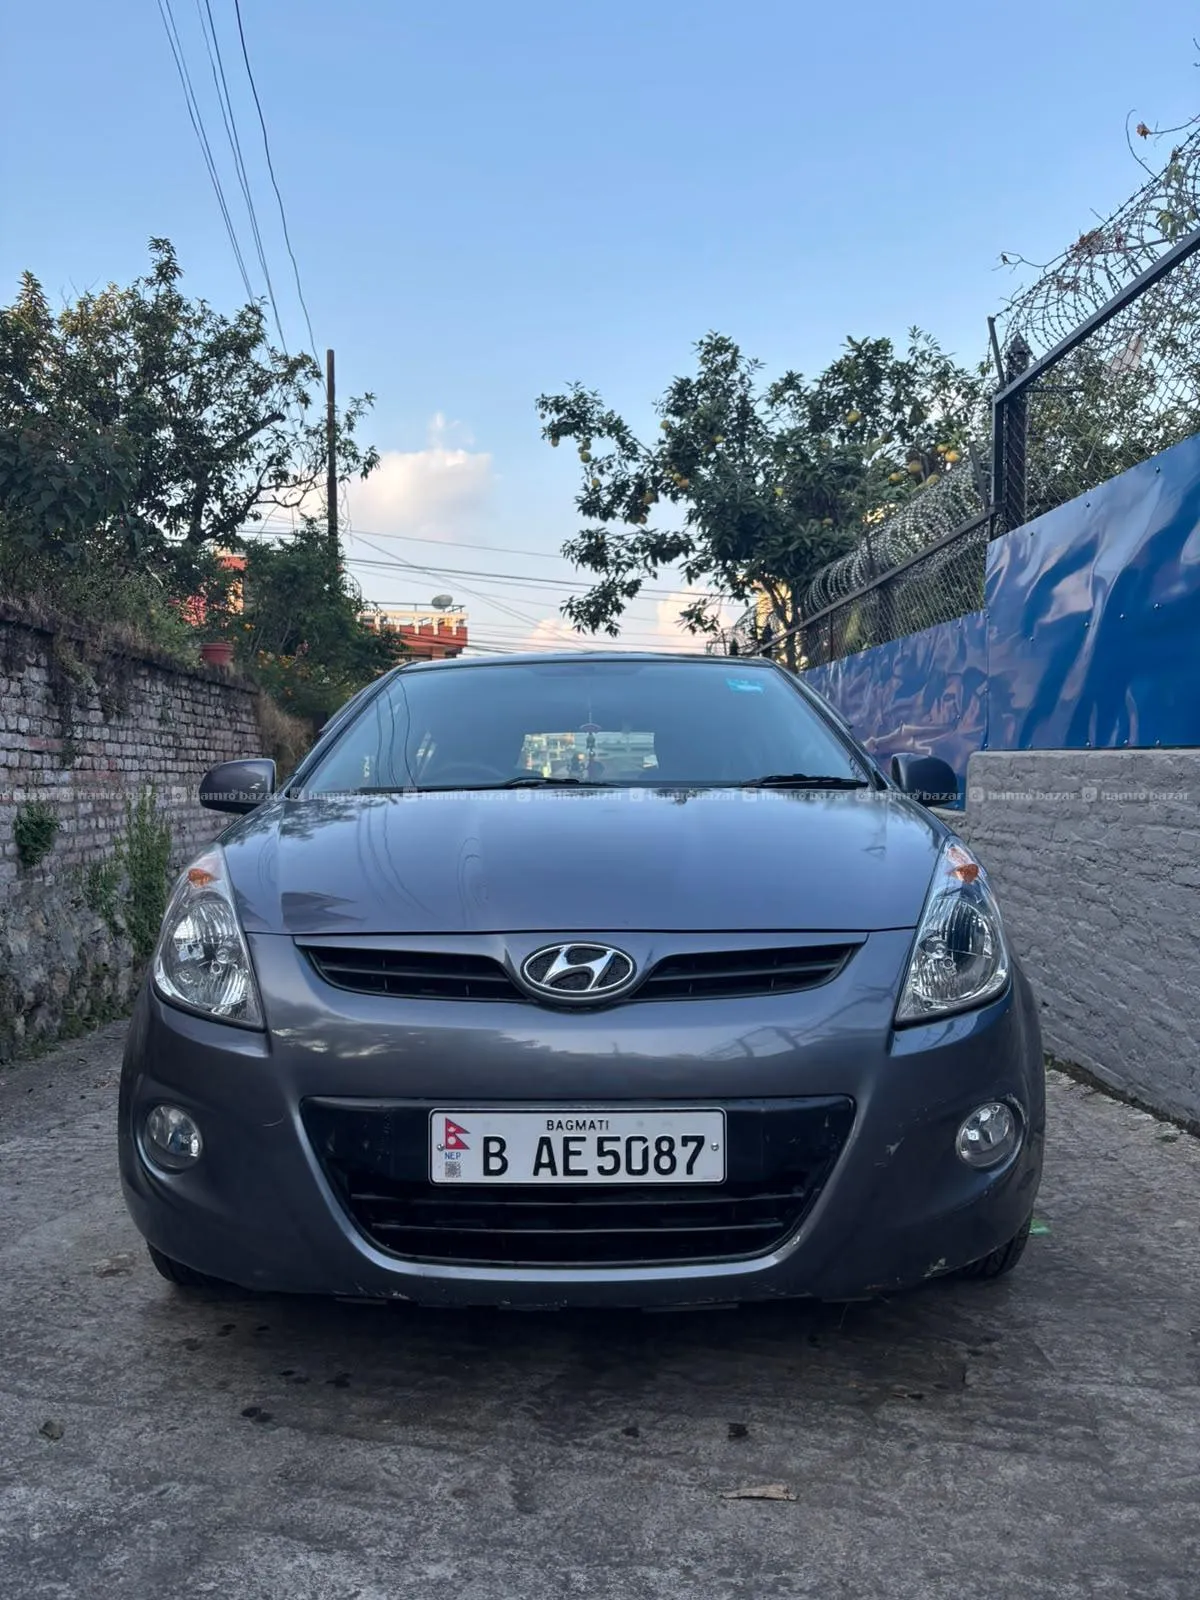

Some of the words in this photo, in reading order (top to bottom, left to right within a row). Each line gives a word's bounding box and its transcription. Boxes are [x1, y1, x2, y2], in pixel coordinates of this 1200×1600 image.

[546, 1119, 610, 1131] BAGMATI
[444, 1152, 461, 1160] NEP
[483, 1136, 508, 1176] B
